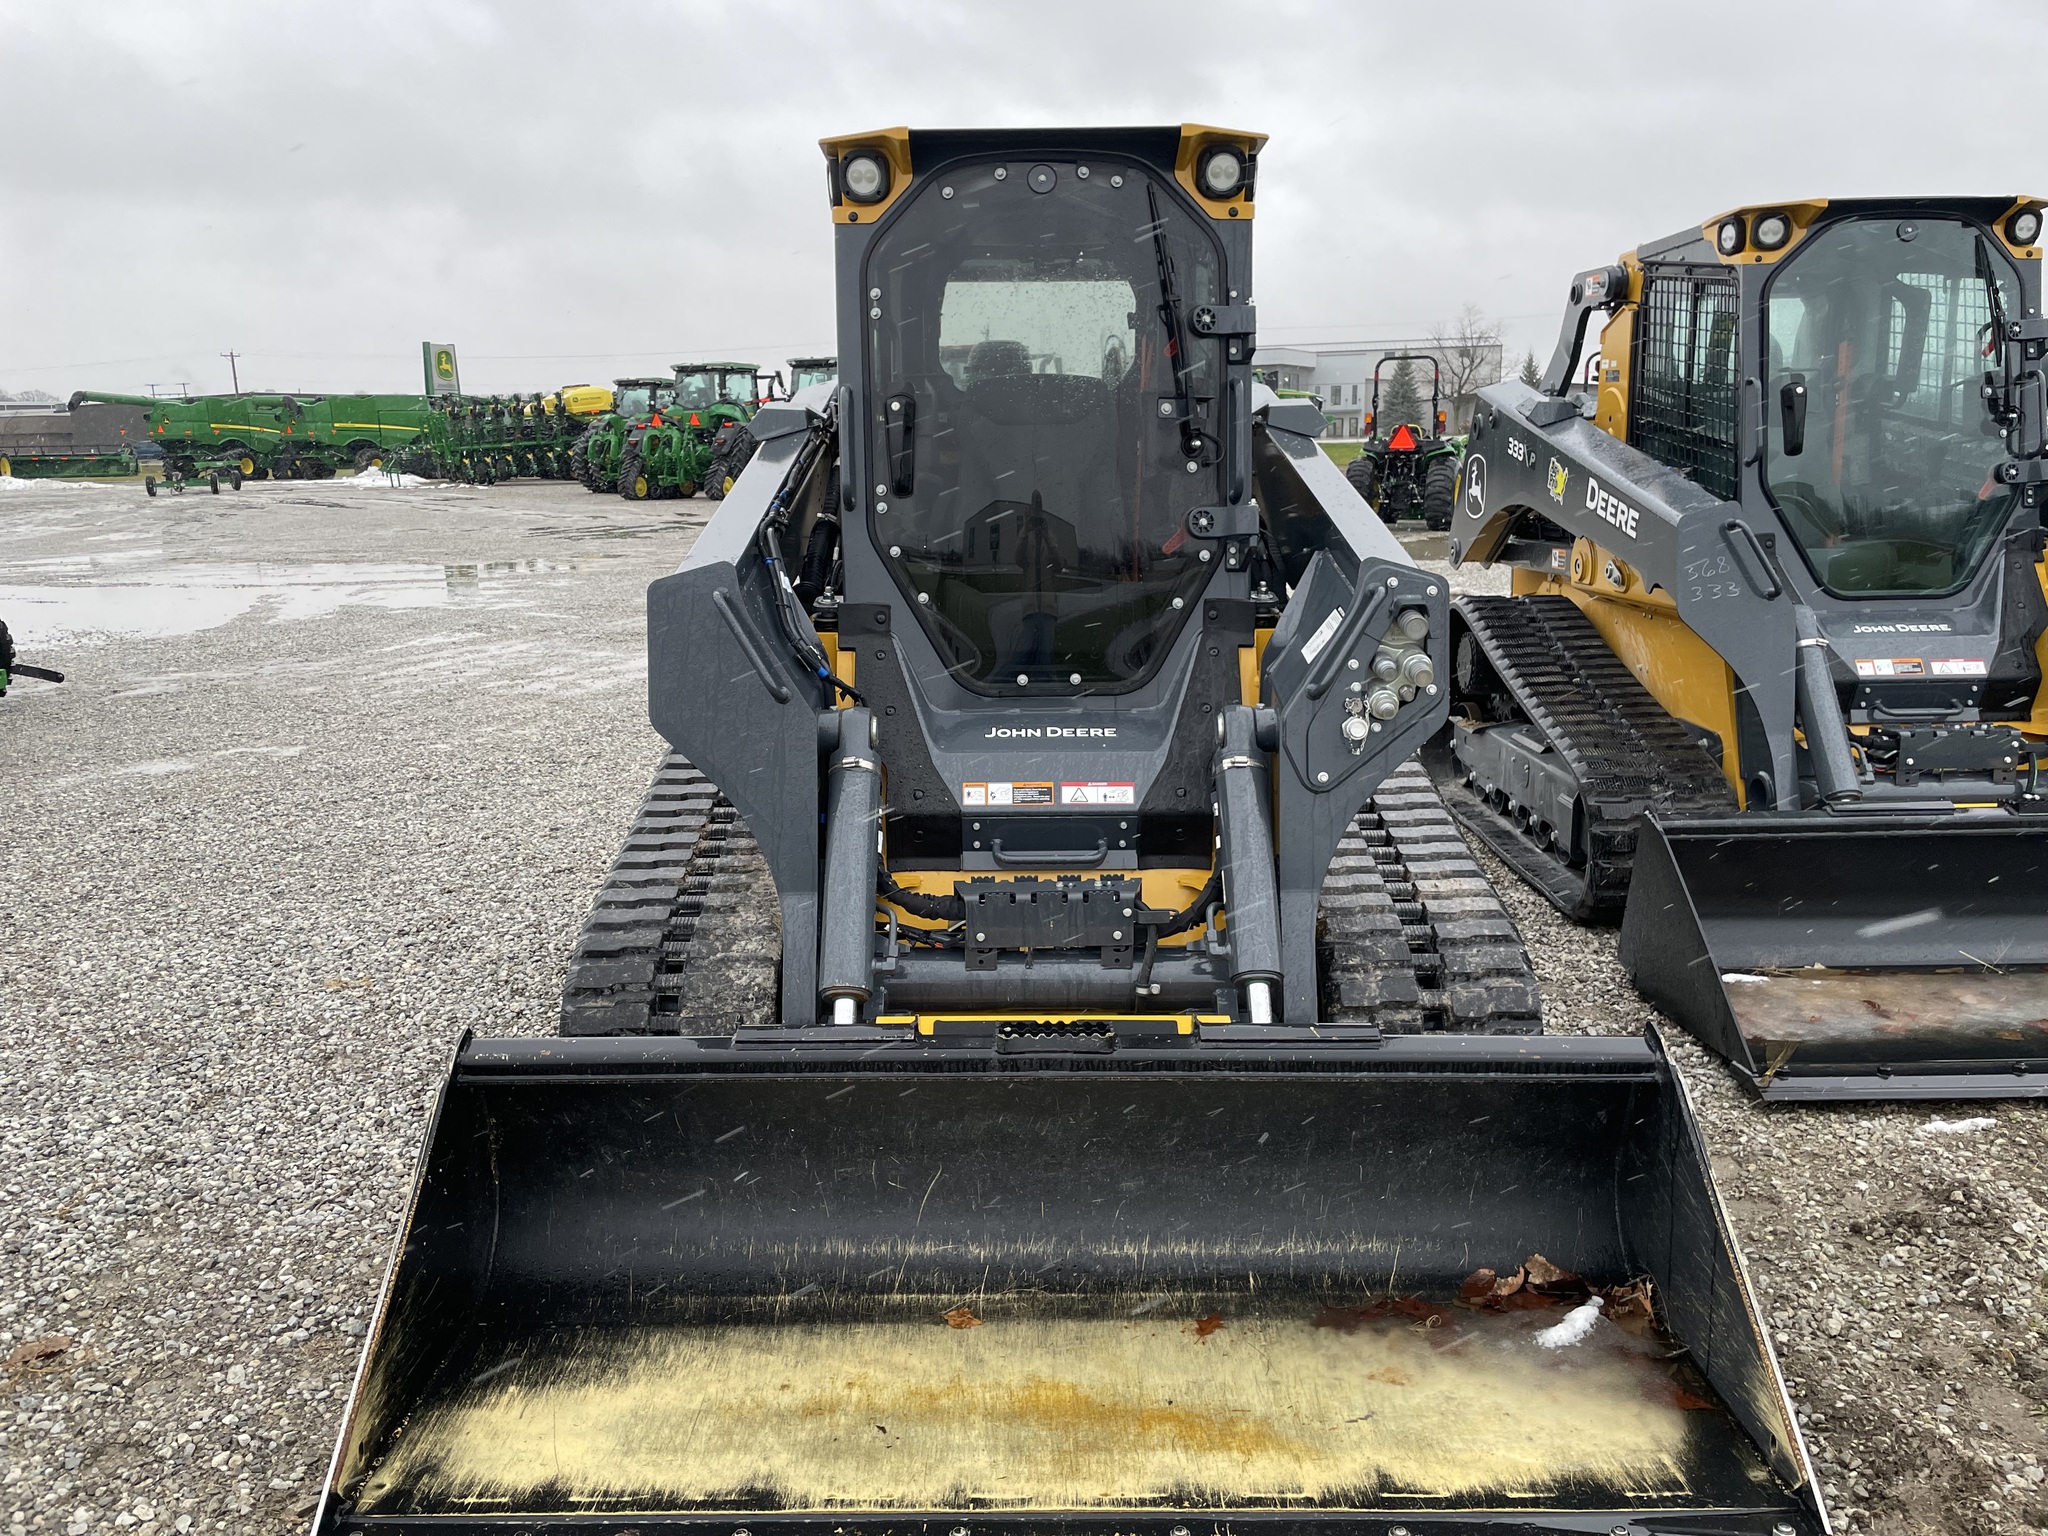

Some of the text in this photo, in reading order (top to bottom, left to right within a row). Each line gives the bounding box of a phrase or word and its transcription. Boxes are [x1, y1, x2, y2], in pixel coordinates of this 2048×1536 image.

[1507, 437, 1525, 462] 333
[1585, 476, 1640, 539] DEERE
[1684, 556, 1731, 582] 368
[1690, 581, 1741, 602] 333
[1853, 624, 1951, 633] JOHN DEERE
[984, 726, 1117, 738] JOHN DEERE
